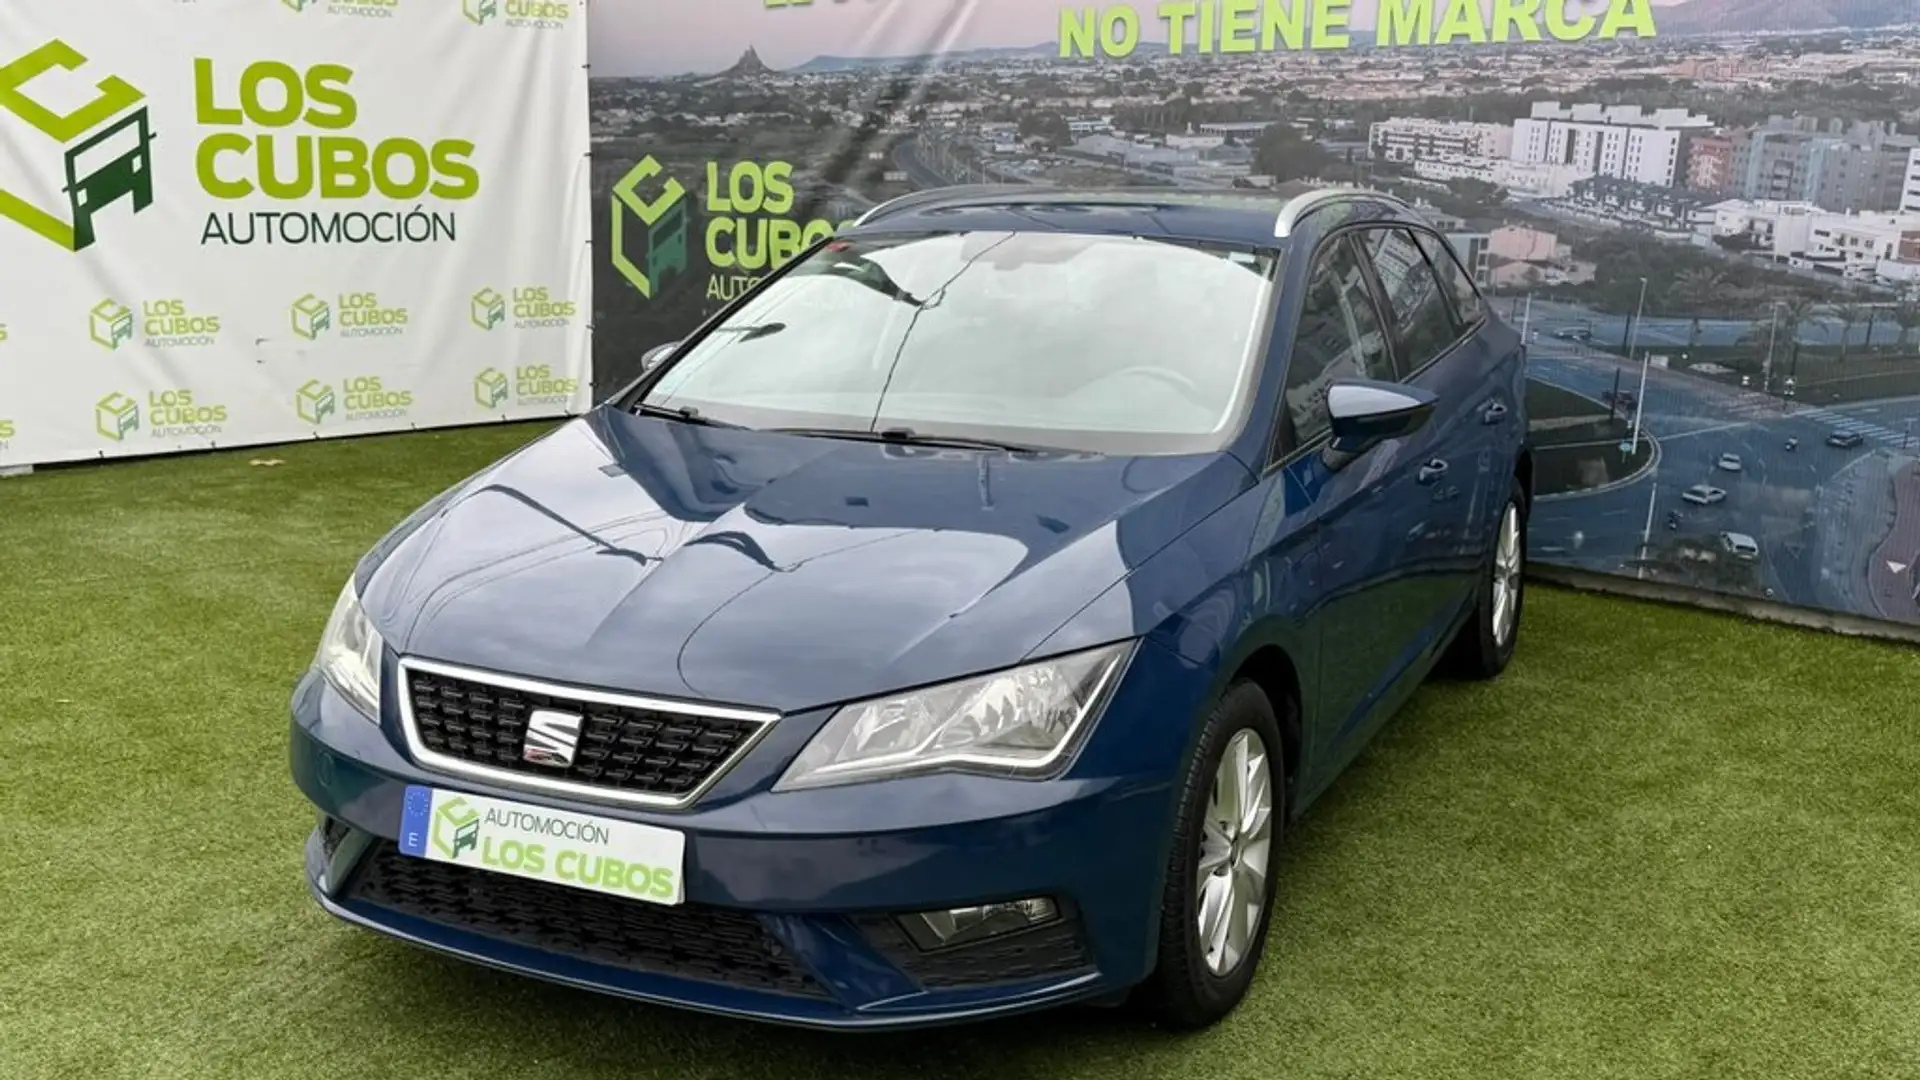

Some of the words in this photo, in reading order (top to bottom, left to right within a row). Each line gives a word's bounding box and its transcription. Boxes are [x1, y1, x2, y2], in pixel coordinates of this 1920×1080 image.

[1059, 7, 1141, 58] NO
[1158, 0, 1351, 55] TIENE
[1376, 0, 1657, 46] MARCA
[194, 58, 358, 129] LOS
[196, 132, 480, 199] CUBOS
[707, 161, 794, 214] LOS
[201, 205, 457, 245] AUTOMOCIÓN
[705, 217, 856, 270] CUBO
[338, 292, 377, 309] LOS
[512, 286, 549, 302] LOS
[143, 300, 185, 317] LOS
[339, 307, 409, 327] CUBOS
[513, 301, 576, 318] CUBOS
[144, 316, 220, 336] CUBOS
[516, 364, 551, 380] LOS
[343, 376, 382, 393] LOS
[516, 378, 579, 396] CUBOS
[149, 389, 192, 407] LOS
[344, 390, 413, 411] CUBOS
[150, 405, 227, 426] CUBOS
[484, 806, 609, 846] AUTOMOCIÓN
[408, 832, 419, 848] E
[482, 836, 546, 874] LOS
[554, 849, 675, 898] CUBOS
